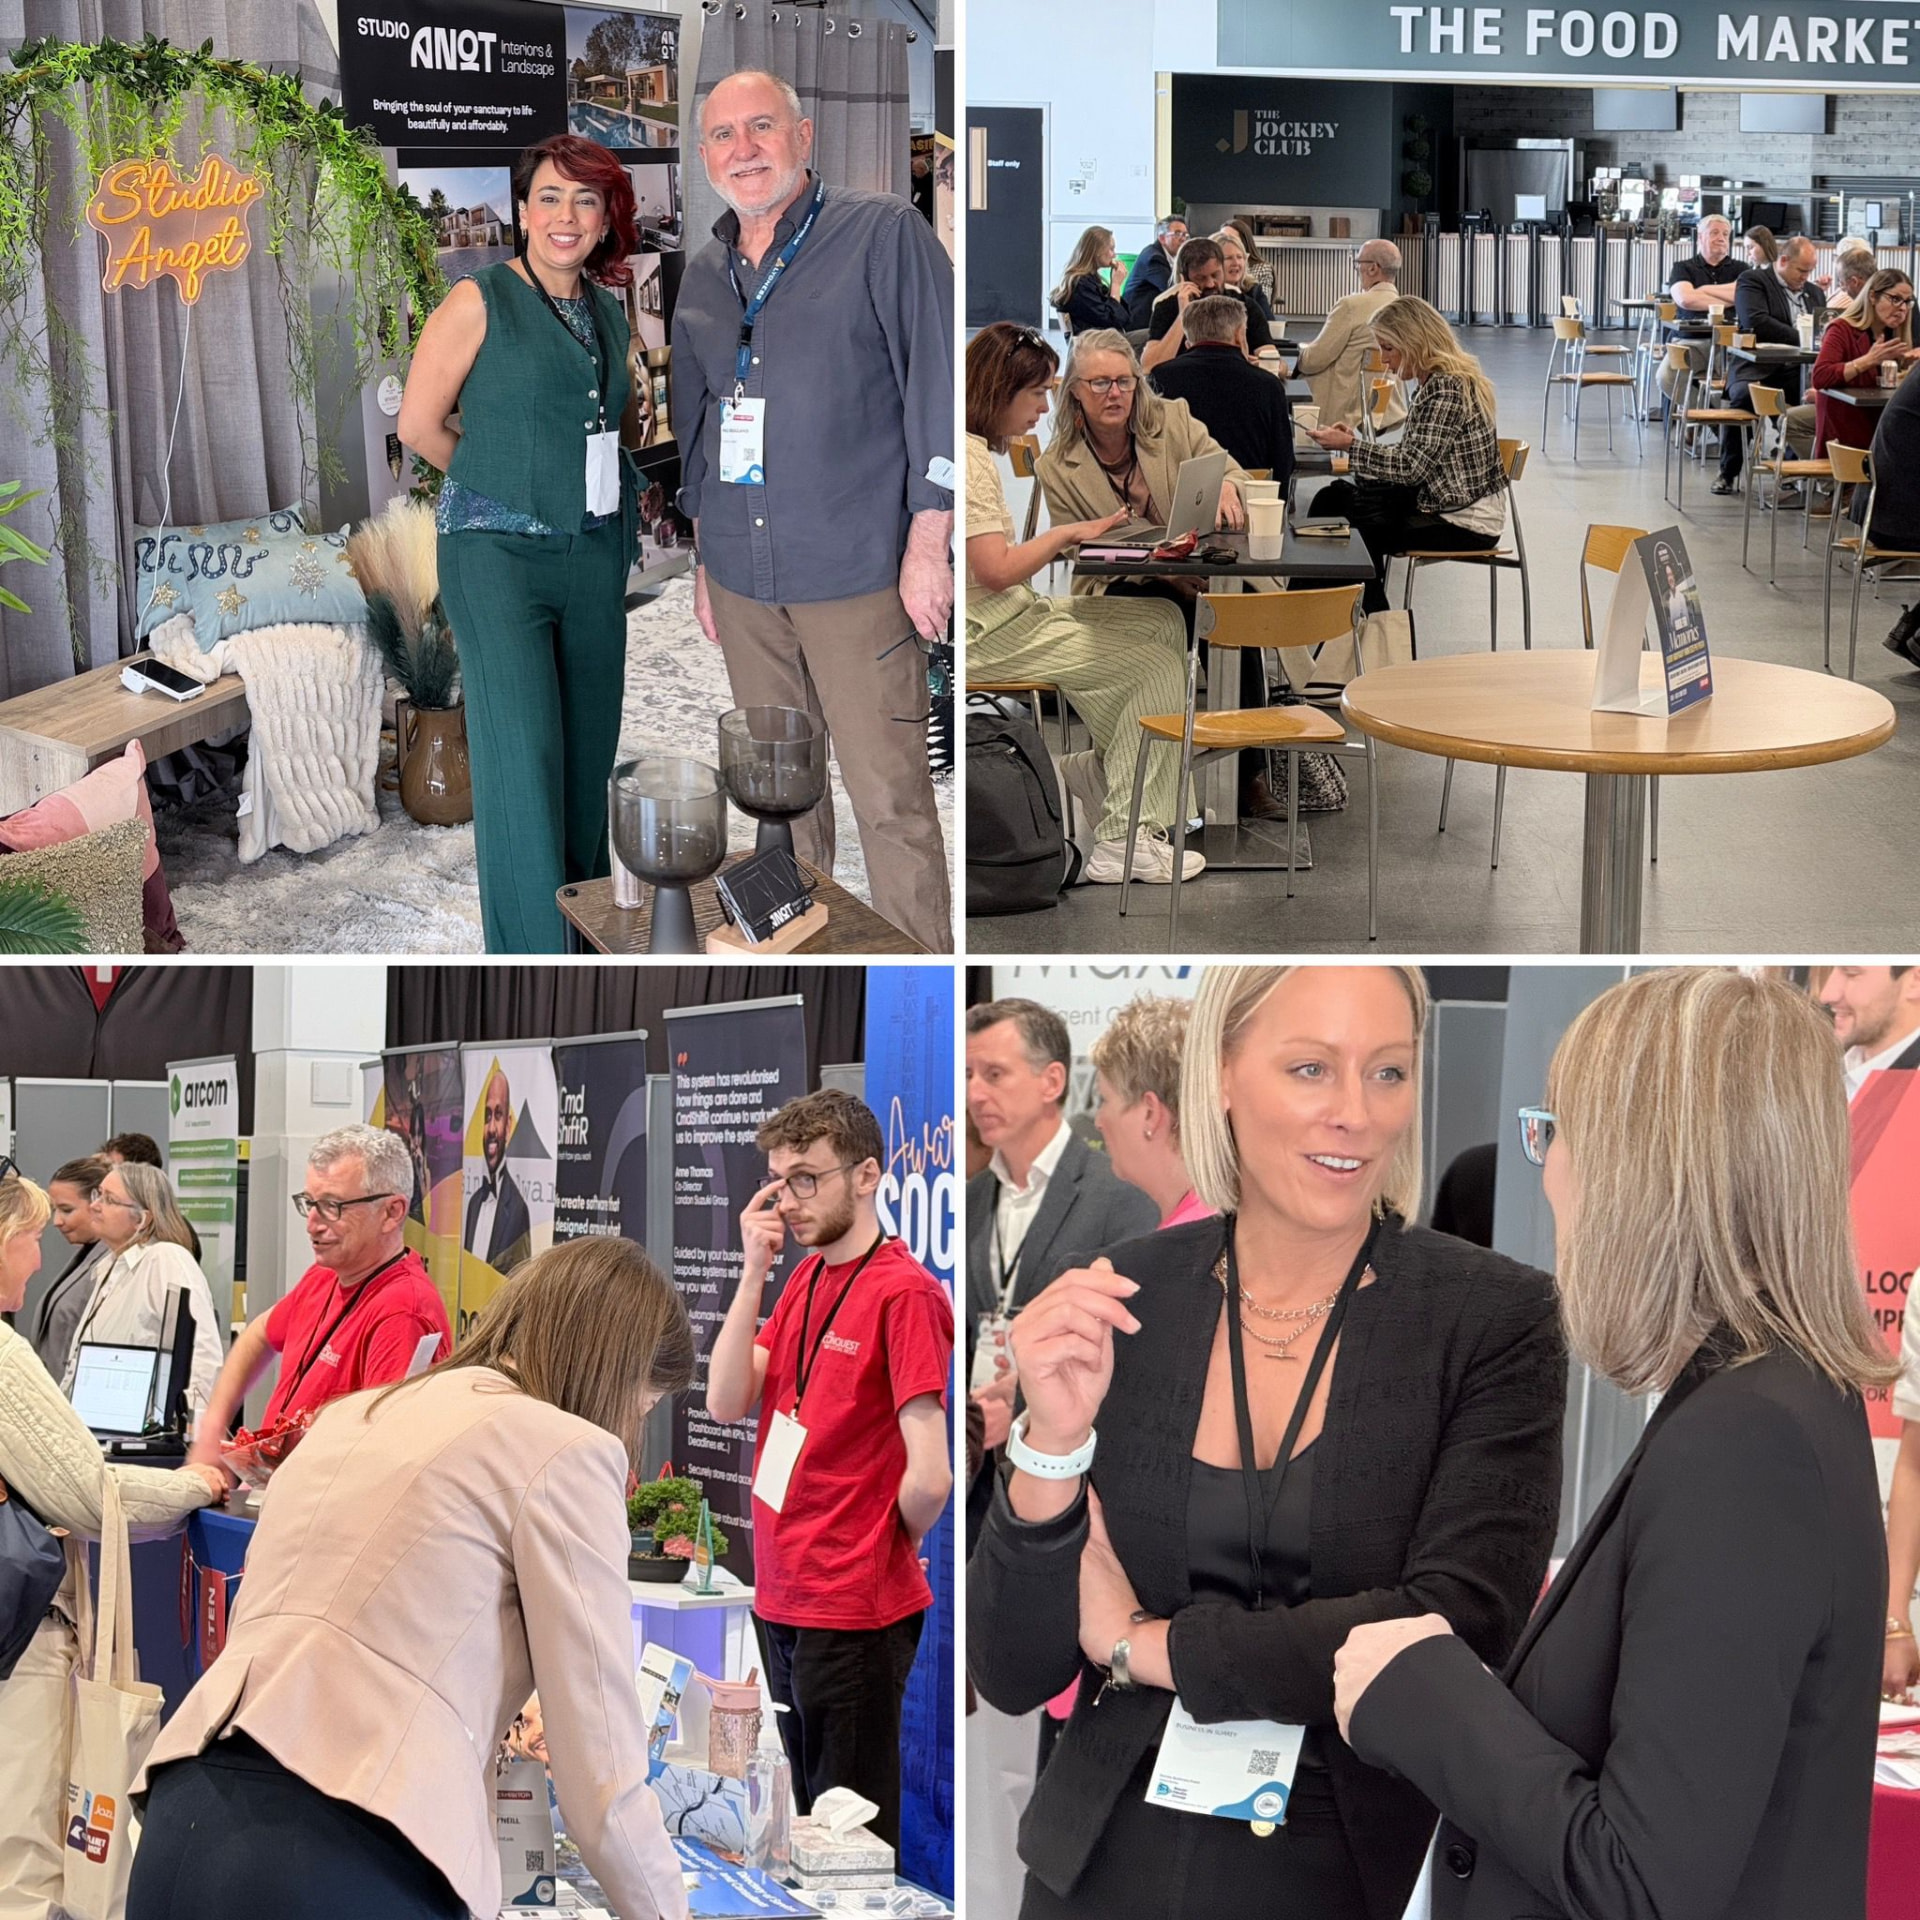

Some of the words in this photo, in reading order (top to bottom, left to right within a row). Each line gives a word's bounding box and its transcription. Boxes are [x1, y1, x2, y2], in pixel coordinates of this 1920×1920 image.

[357, 17, 410, 40] STUDIO
[1390, 6, 1502, 55] THE
[1526, 9, 1678, 59] FOOD
[1717, 14, 1920, 65] MARKE
[501, 39, 543, 58] Interiors
[545, 44, 553, 58] &
[501, 58, 555, 79] Landscape
[373, 98, 409, 115] Bringing
[409, 101, 424, 113] the
[425, 101, 443, 113] soul
[443, 102, 452, 114] of
[453, 104, 473, 116] your
[473, 104, 512, 117] sanctuary
[513, 104, 521, 116] to
[1254, 110, 1280, 120] THE
[407, 118, 450, 133] beautifully
[452, 119, 467, 131] and
[468, 119, 509, 134] affordably.
[1254, 122, 1339, 139] JOCKEY
[1254, 140, 1311, 156] CLUB
[988, 159, 1003, 167] Staff
[1005, 160, 1020, 169] only
[95, 160, 259, 224] Studio
[756, 267, 779, 300] LYONESS
[677, 1075, 690, 1088] This
[691, 1075, 715, 1090] system
[716, 1073, 731, 1087] has
[731, 1068, 779, 1086] revolutionised
[184, 1079, 227, 1108] arcom
[560, 1084, 585, 1114] Cmd
[676, 1094, 691, 1107] how
[692, 1092, 713, 1109] things
[714, 1094, 728, 1105] are
[729, 1091, 748, 1106] done
[748, 1089, 763, 1104] and
[676, 1110, 709, 1126] CmdShiftR
[710, 1110, 741, 1125] continue
[742, 1110, 749, 1124] to
[749, 1108, 766, 1122] work
[675, 1132, 684, 1144] us
[685, 1131, 692, 1144] to
[693, 1130, 724, 1146] improve
[724, 1129, 736, 1143] the
[690, 1166, 714, 1178] Thomas
[674, 1180, 703, 1192] Co-Director
[561, 1195, 585, 1210] create
[674, 1195, 694, 1205] London
[712, 1195, 729, 1207] Group
[556, 1216, 588, 1238] designed
[674, 1247, 696, 1259] Guided
[697, 1247, 706, 1262] by
[708, 1250, 722, 1263] your
[723, 1249, 745, 1261] busine
[674, 1264, 701, 1277] bespoke
[702, 1266, 727, 1279] systems
[728, 1265, 738, 1278] will
[686, 1282, 699, 1294] you
[688, 1309, 716, 1321] Automate
[1863, 1387, 1888, 1401] OR
[688, 1435, 717, 1450] Deadlines
[688, 1464, 712, 1480] Securely
[712, 1470, 726, 1481] store
[726, 1472, 738, 1483] and
[208, 1587, 216, 1636] TEN
[735, 1869, 765, 1895] Directory
